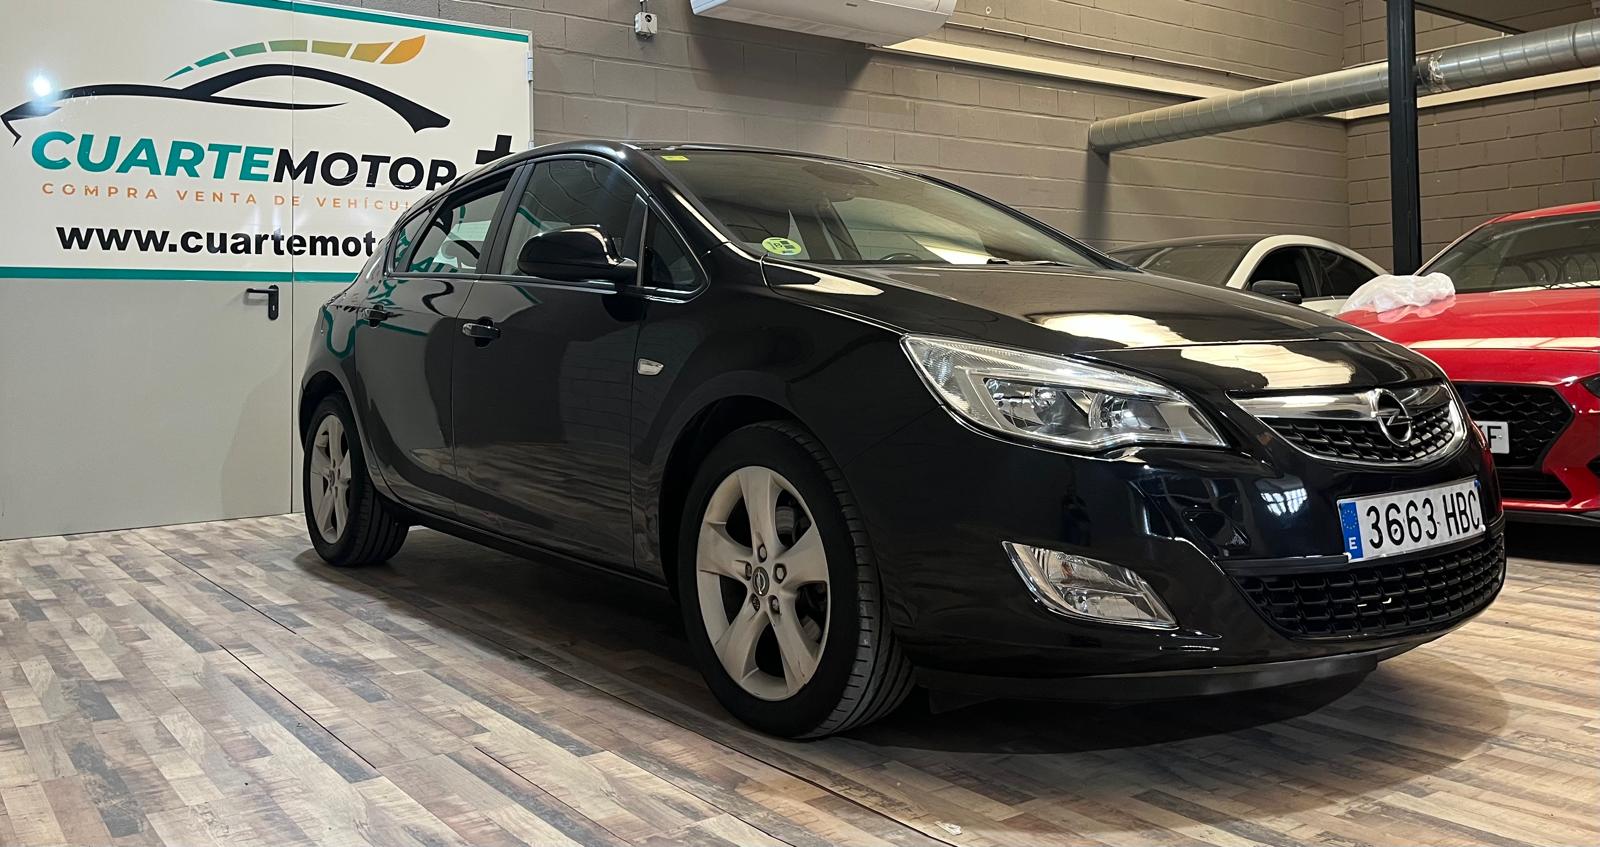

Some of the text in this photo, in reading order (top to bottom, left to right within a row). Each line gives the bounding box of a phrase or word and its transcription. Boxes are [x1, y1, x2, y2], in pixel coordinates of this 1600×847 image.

[42, 183, 157, 199] COMPRA
[177, 190, 256, 204] VENTA
[274, 195, 300, 206] DE
[56, 226, 383, 257] www.cuartemot
[1366, 490, 1480, 549] 3663 HBC
[1348, 537, 1358, 550] E
